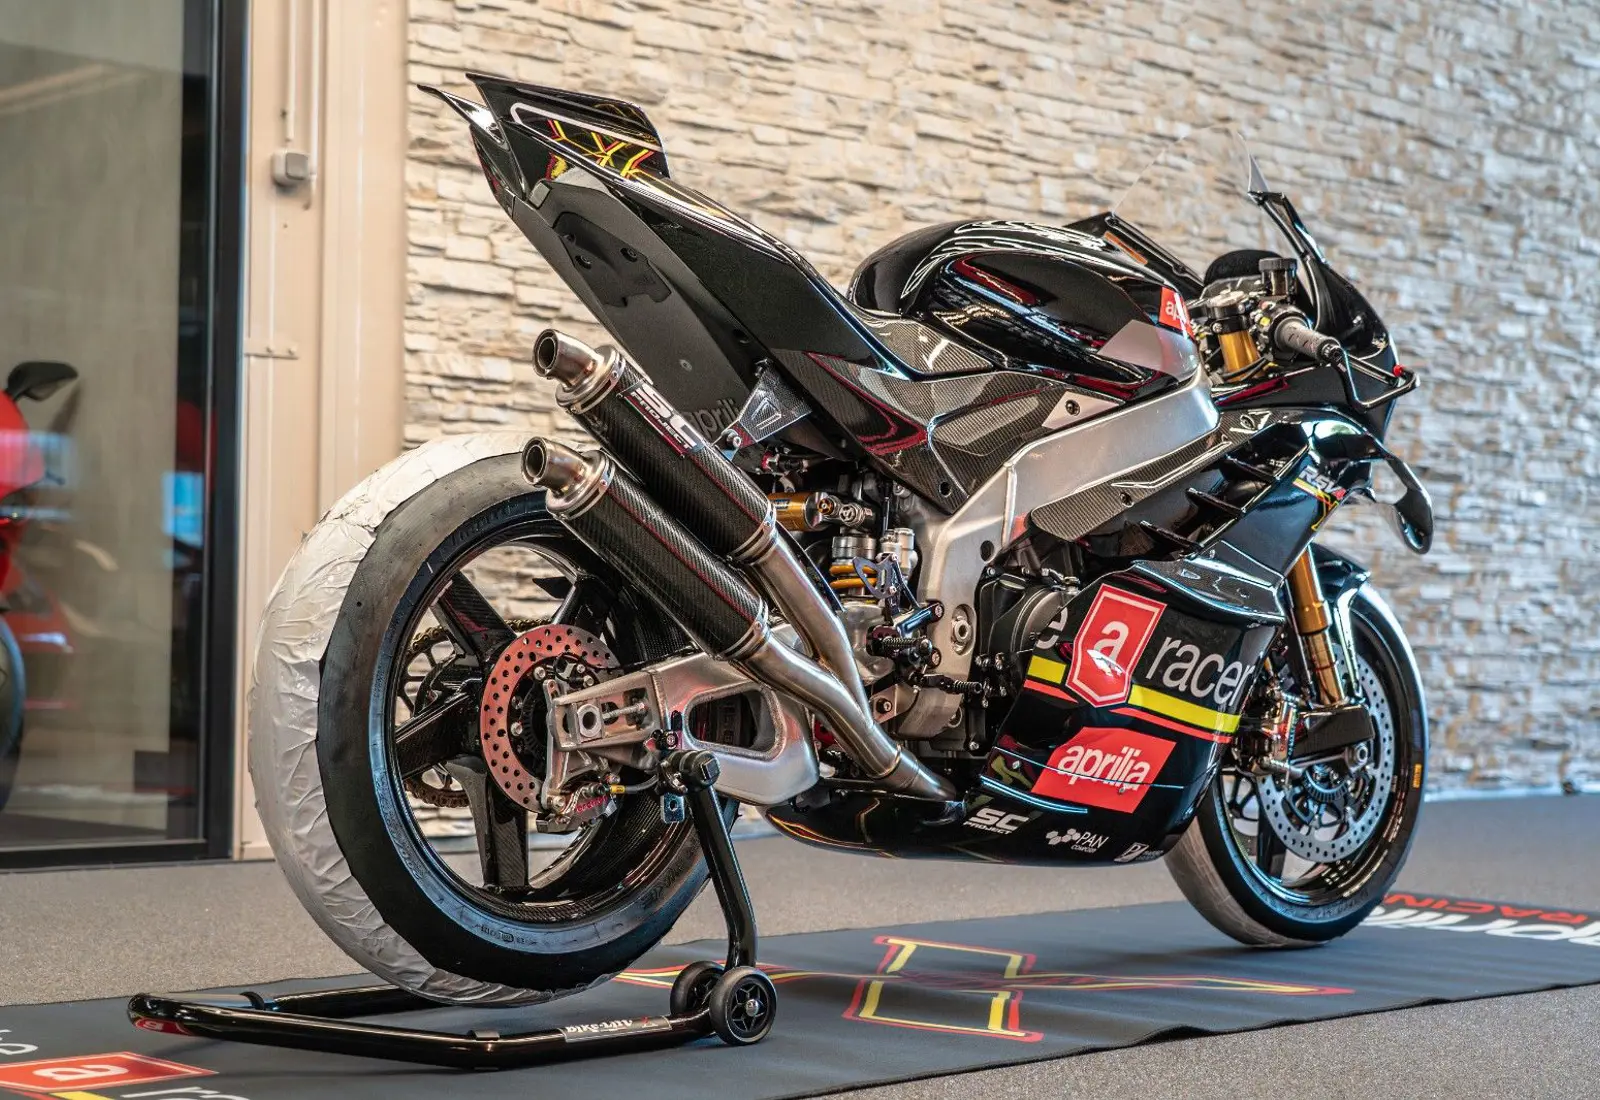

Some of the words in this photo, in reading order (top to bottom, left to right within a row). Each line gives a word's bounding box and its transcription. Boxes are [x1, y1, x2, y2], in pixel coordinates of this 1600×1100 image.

[630, 391, 692, 450] PROJECT
[1146, 636, 1254, 704] racer
[1056, 745, 1151, 791] aprilia
[963, 821, 1012, 835] PROJECT
[969, 807, 1030, 831] SC
[1075, 831, 1109, 849] PAN
[1383, 893, 1588, 924] RACIN
